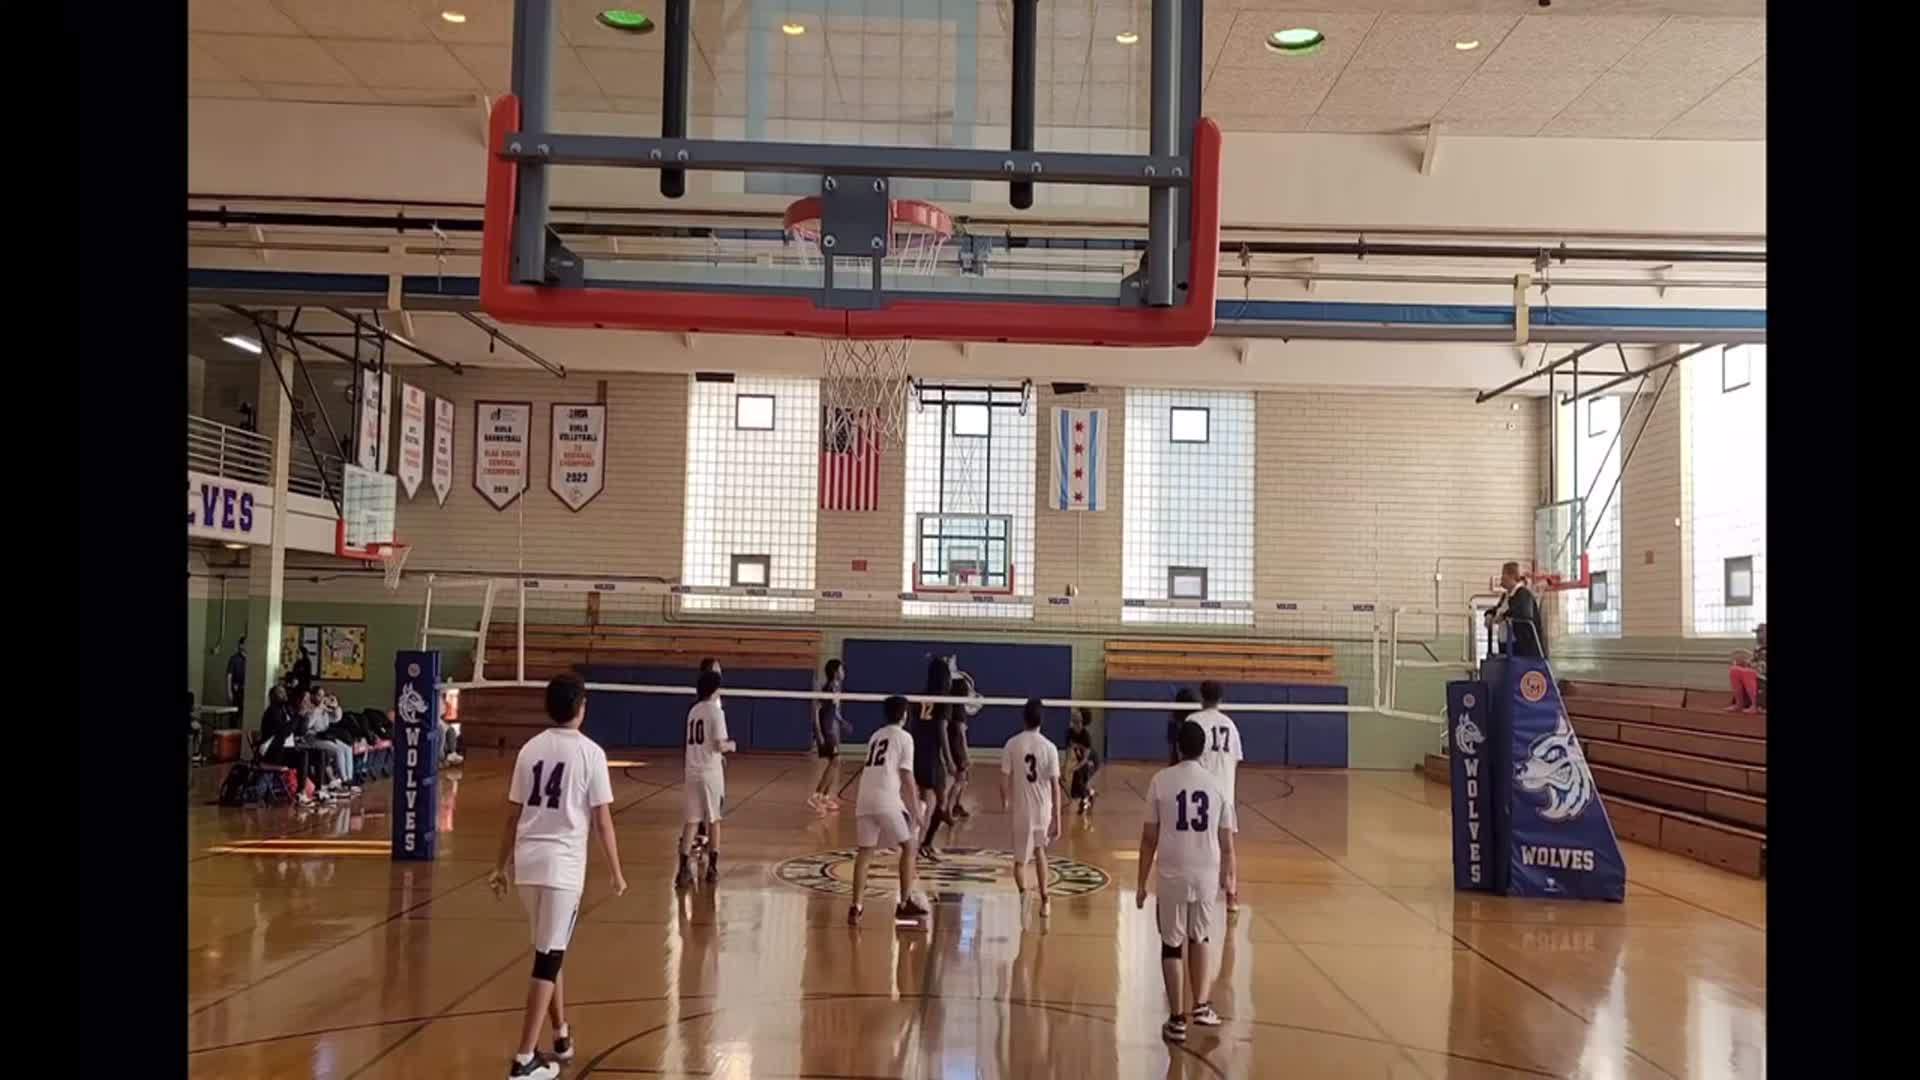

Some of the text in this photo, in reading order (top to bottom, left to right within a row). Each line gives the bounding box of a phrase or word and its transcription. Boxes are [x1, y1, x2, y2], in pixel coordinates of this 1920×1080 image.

[559, 433, 597, 441] VOLLEYBALL
[188, 484, 254, 532] VES
[865, 739, 889, 767] 12
[1211, 726, 1230, 752] 17
[527, 759, 565, 809] 14
[1024, 754, 1038, 783] 3
[405, 727, 421, 851] WOLVES
[1175, 789, 1209, 832] 13
[1464, 757, 1481, 883] WOLVES
[1520, 845, 1595, 871] WOLVES
